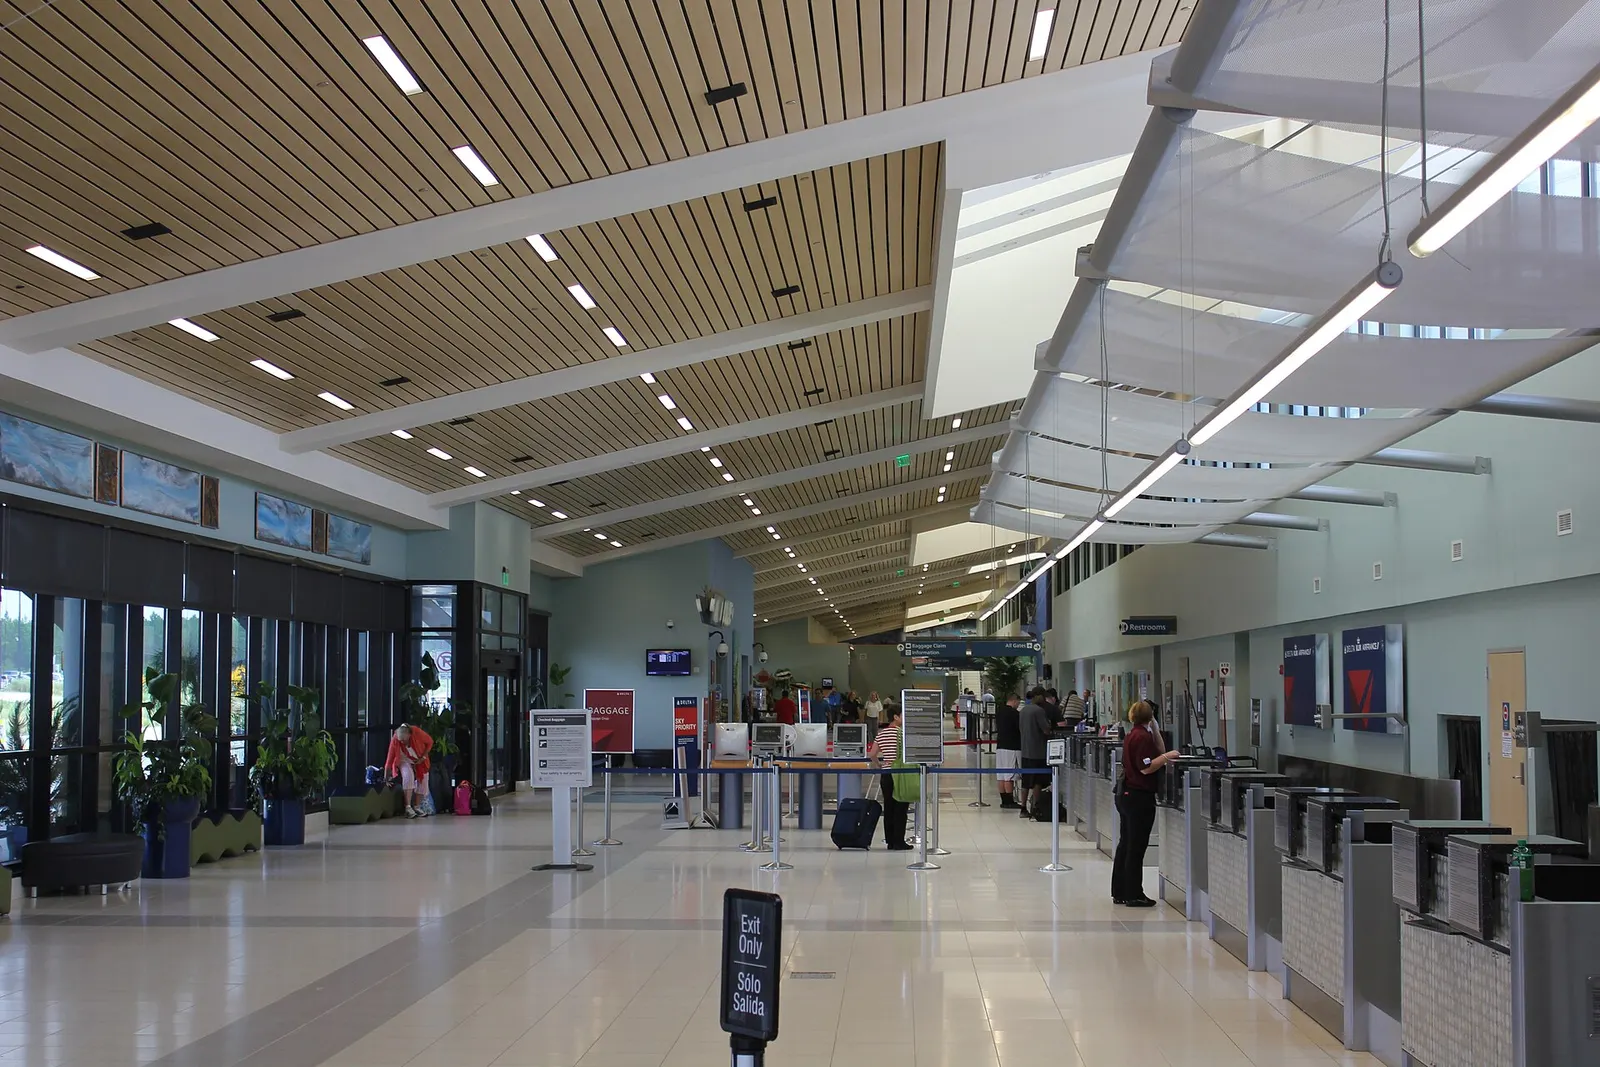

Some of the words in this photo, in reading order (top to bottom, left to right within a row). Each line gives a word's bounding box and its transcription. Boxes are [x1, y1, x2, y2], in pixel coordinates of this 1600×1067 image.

[1129, 623, 1166, 631] Restrooms
[741, 914, 761, 935] Exit
[738, 934, 763, 960] Only
[737, 971, 761, 994] Sólo
[733, 992, 765, 1016] Salida
